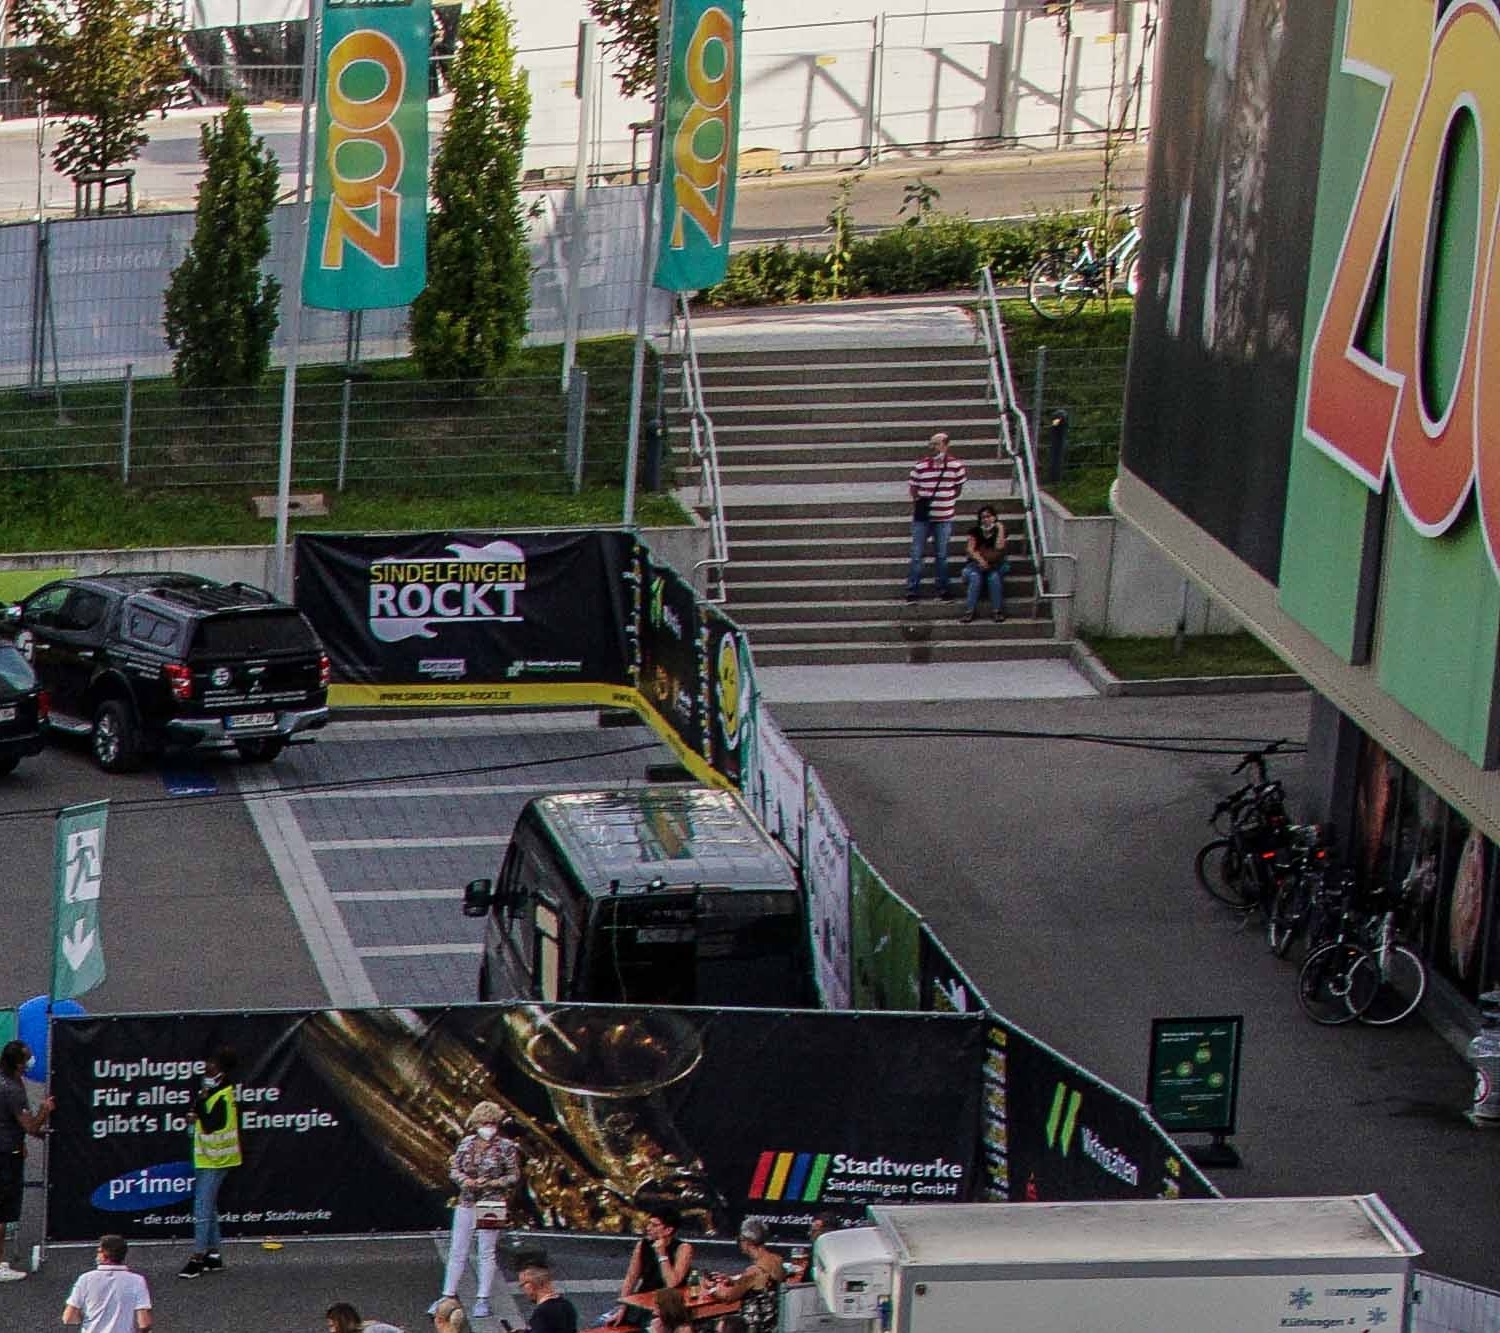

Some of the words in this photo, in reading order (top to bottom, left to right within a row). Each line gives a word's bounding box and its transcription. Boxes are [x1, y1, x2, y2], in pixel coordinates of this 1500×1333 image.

[671, 7, 733, 250] ZOO
[321, 29, 407, 270] ZOO
[1304, 0, 1500, 586] ZO
[370, 562, 526, 583] SINDELFINGEN
[370, 581, 525, 617] ROCKT
[93, 1087, 131, 1107] Für
[137, 1085, 190, 1106] alles
[92, 1112, 158, 1139] gibt's
[242, 1108, 340, 1132] Energie.
[833, 1153, 963, 1179] Stadtwerke
[826, 1177, 908, 1196] Sindelfingen
[911, 1181, 958, 1195] GmbH
[143, 1213, 161, 1225] die
[242, 1211, 263, 1223] der
[265, 1208, 333, 1223] Stadtwerke
